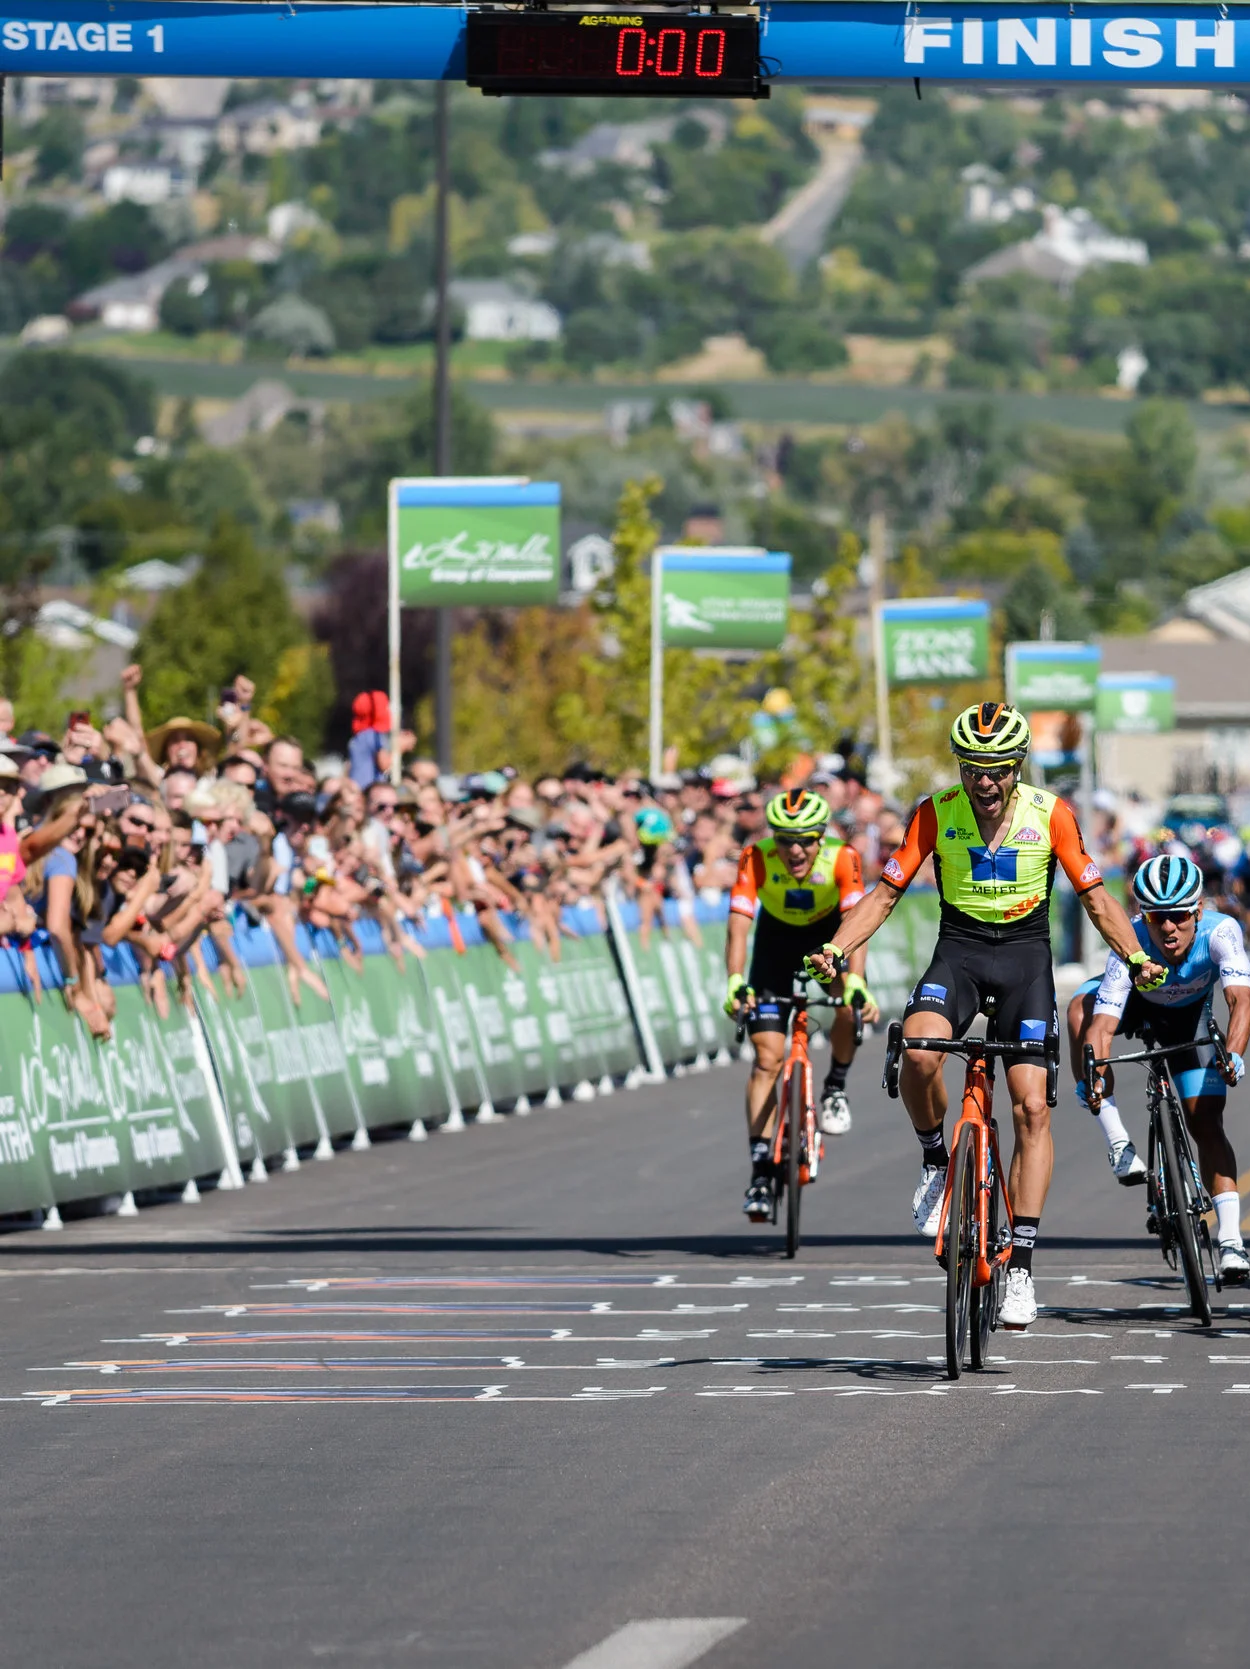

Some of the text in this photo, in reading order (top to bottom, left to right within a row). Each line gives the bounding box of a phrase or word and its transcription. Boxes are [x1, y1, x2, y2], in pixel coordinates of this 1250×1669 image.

[2, 21, 164, 53] STAGE 1
[615, 28, 726, 77] 0:00
[904, 17, 1236, 68] FINISH
[972, 885, 1017, 895] METER
[919, 995, 945, 1006] METER
[0, 1107, 35, 1164] TAH
[581, 1384, 1017, 1392] UTAH
